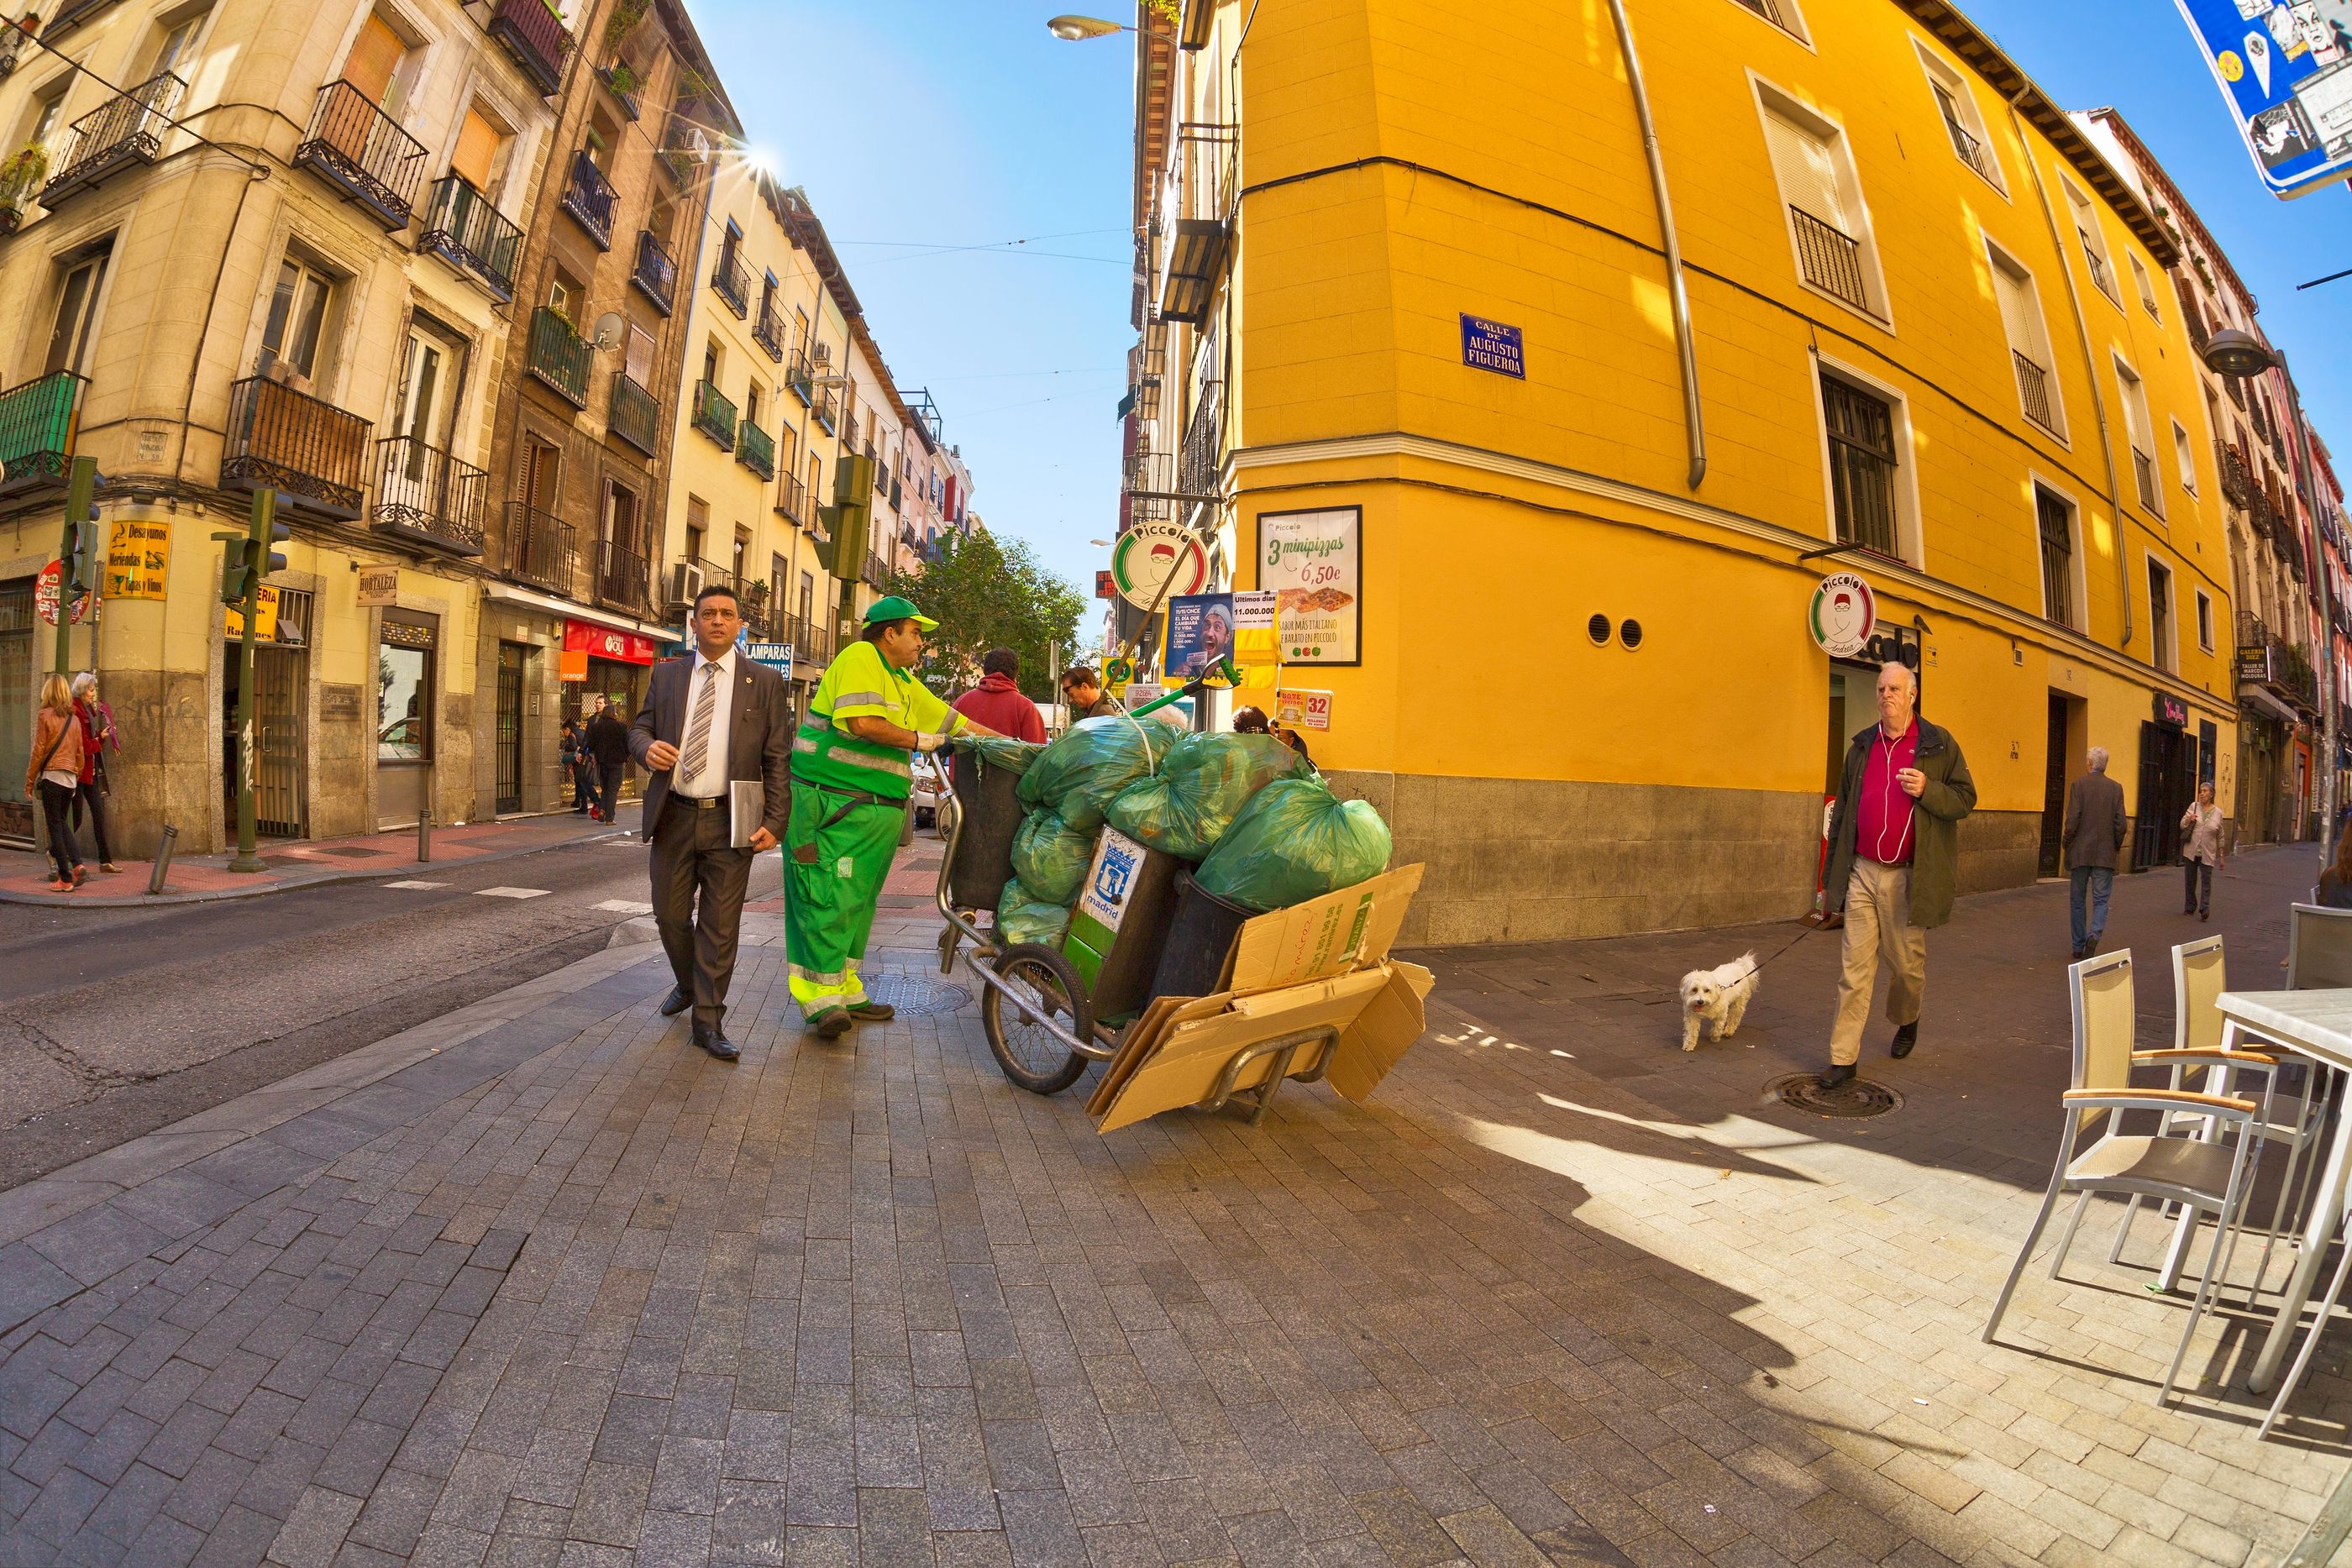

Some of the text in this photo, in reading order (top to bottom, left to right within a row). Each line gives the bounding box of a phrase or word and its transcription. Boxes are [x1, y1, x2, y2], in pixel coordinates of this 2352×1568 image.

[1475, 321, 1510, 336] CALLE
[1487, 333, 1501, 341] DE
[1469, 336, 1518, 359] AUGUSTO
[1468, 349, 1521, 374] FIGUEROA
[129, 524, 167, 542] Desayunos
[1134, 524, 1190, 543] Piccolo
[1275, 522, 1301, 531] Piccolo
[1268, 539, 1281, 565] 3
[1283, 537, 1345, 558] minipizzas
[109, 553, 141, 567] Meriendas
[125, 576, 141, 595] Tapas
[147, 578, 162, 593] Vinos
[360, 576, 397, 591] HORTALEZA
[1821, 576, 1859, 593] Piccolo
[257, 588, 276, 604] ERIA
[1279, 618, 1337, 631] SABOR MÁS ITALIANO
[1284, 633, 1304, 643] BARATO
[1305, 633, 1313, 643] EN
[1314, 632, 1337, 642] PICCOLO
[746, 644, 790, 661] LAMPARAS
[1856, 628, 1918, 669] ccolo
[1282, 692, 1302, 700] BOTE
[1308, 697, 1327, 714] 32
[1087, 894, 1119, 920] madrid
[1315, 903, 1344, 973] www.ramirez.es
